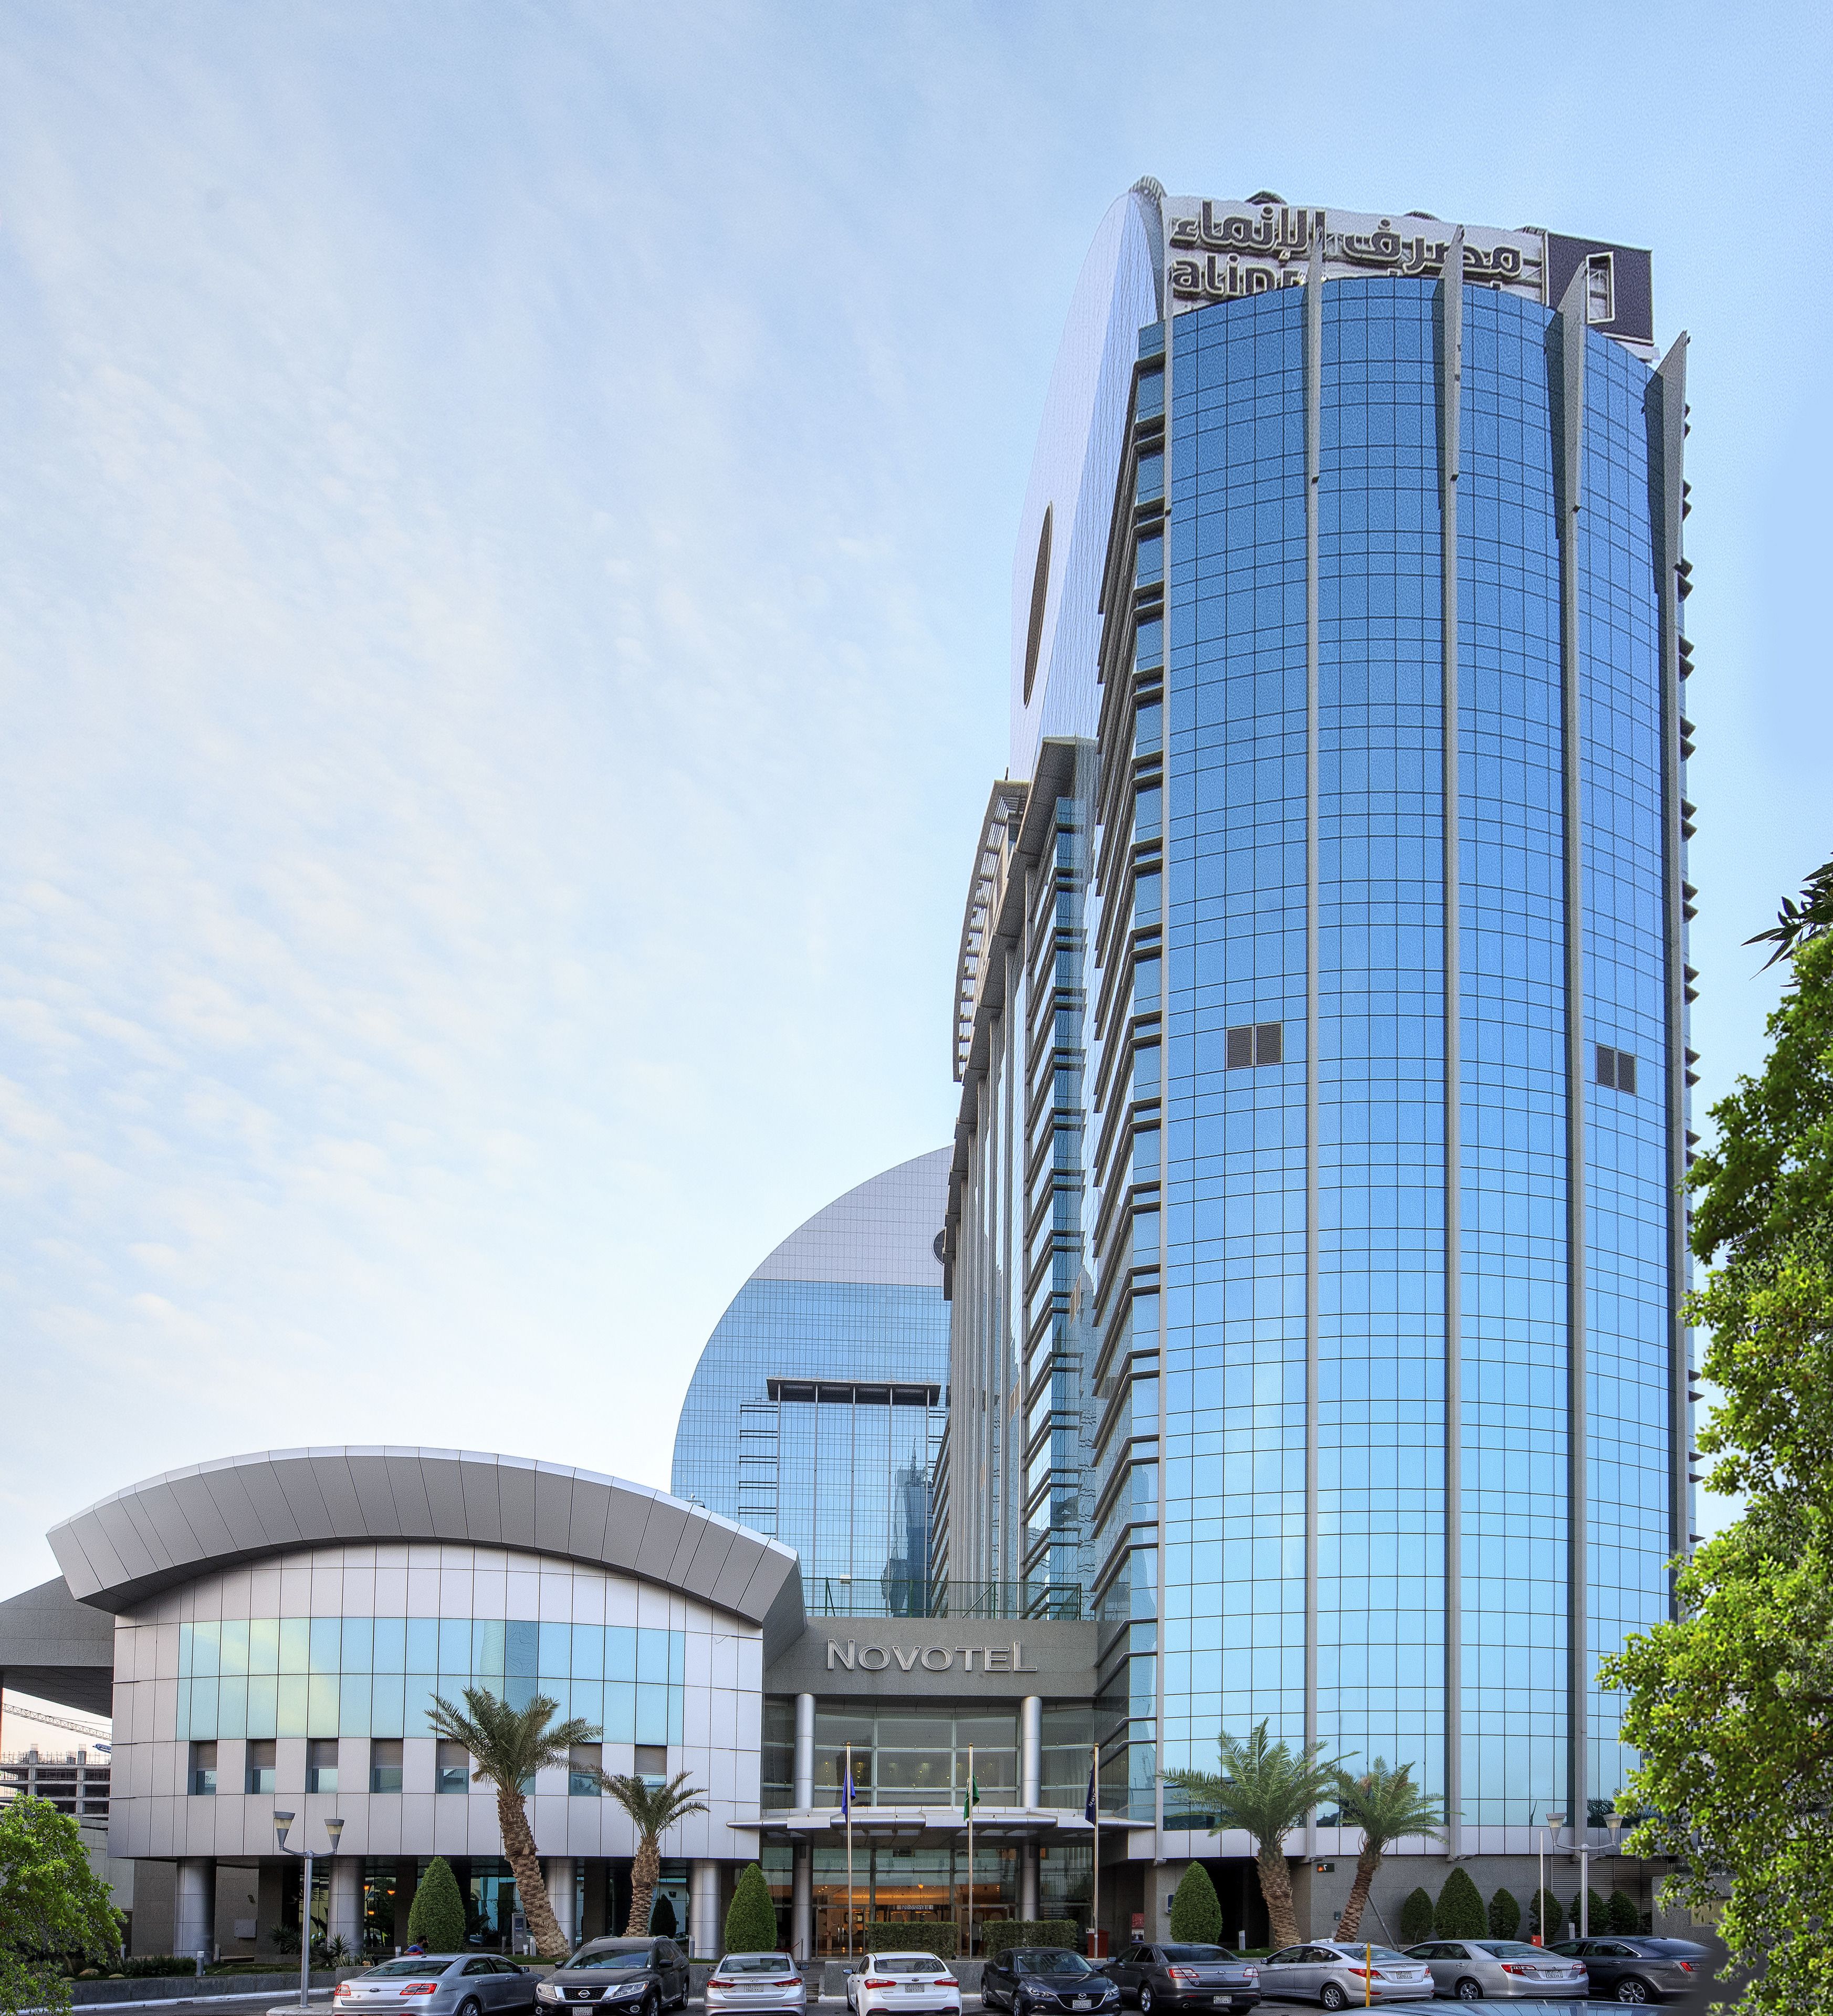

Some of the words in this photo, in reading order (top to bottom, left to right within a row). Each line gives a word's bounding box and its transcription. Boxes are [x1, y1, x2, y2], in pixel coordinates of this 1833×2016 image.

[1170, 200, 1326, 262] الإنماء
[1342, 217, 1524, 278] مصرف
[827, 1639, 1038, 1672] NOVOTEL
